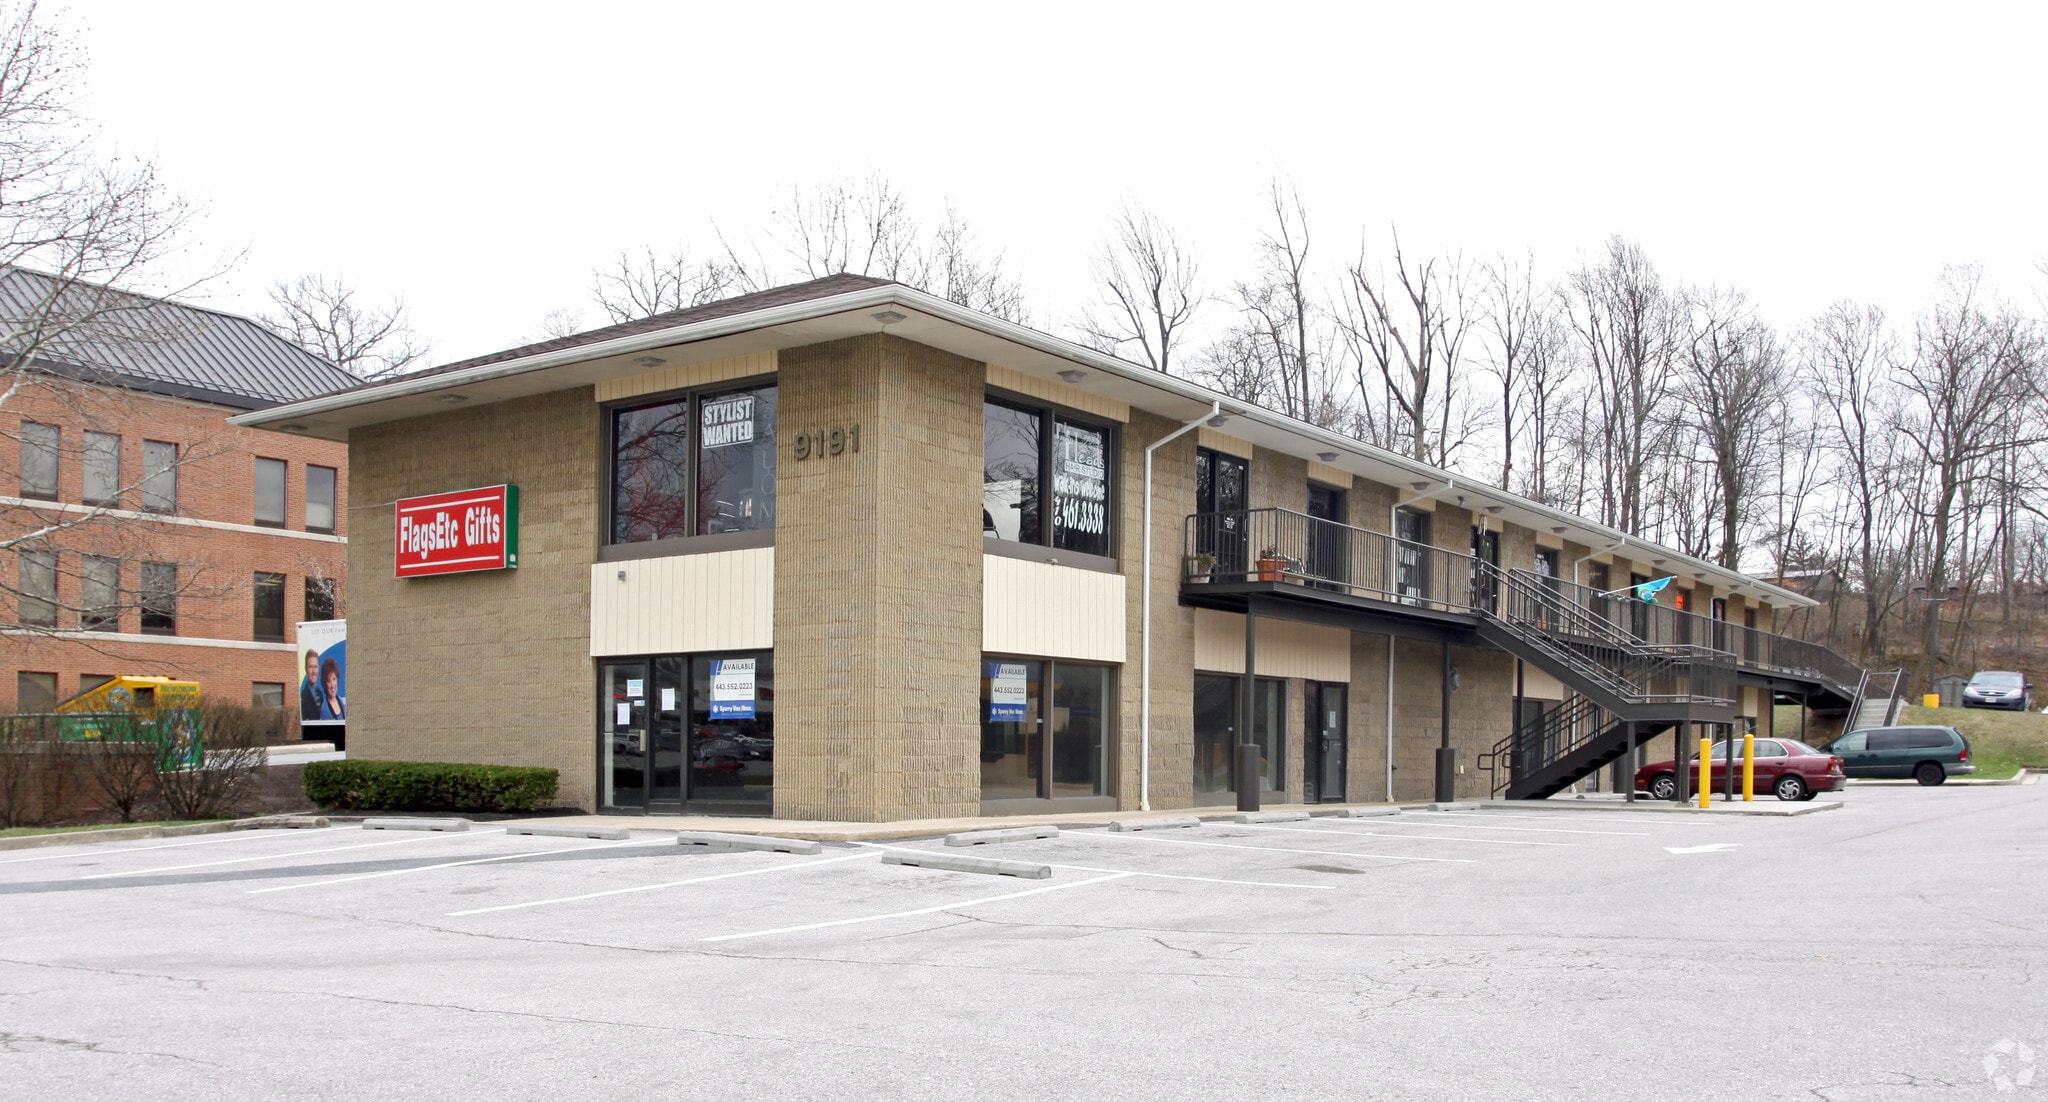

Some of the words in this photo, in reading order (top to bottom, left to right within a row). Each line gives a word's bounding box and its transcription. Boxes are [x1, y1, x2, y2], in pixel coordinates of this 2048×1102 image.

[704, 399, 752, 425] STYLIST
[703, 420, 753, 446] WANTED
[794, 424, 859, 460] 9191
[1065, 460, 1080, 472] HAIR
[1062, 497, 1104, 535] 461.3338
[400, 511, 458, 560] FlagsEtc
[465, 506, 500, 546] Gifts
[994, 686, 1024, 694] 443.552.0223
